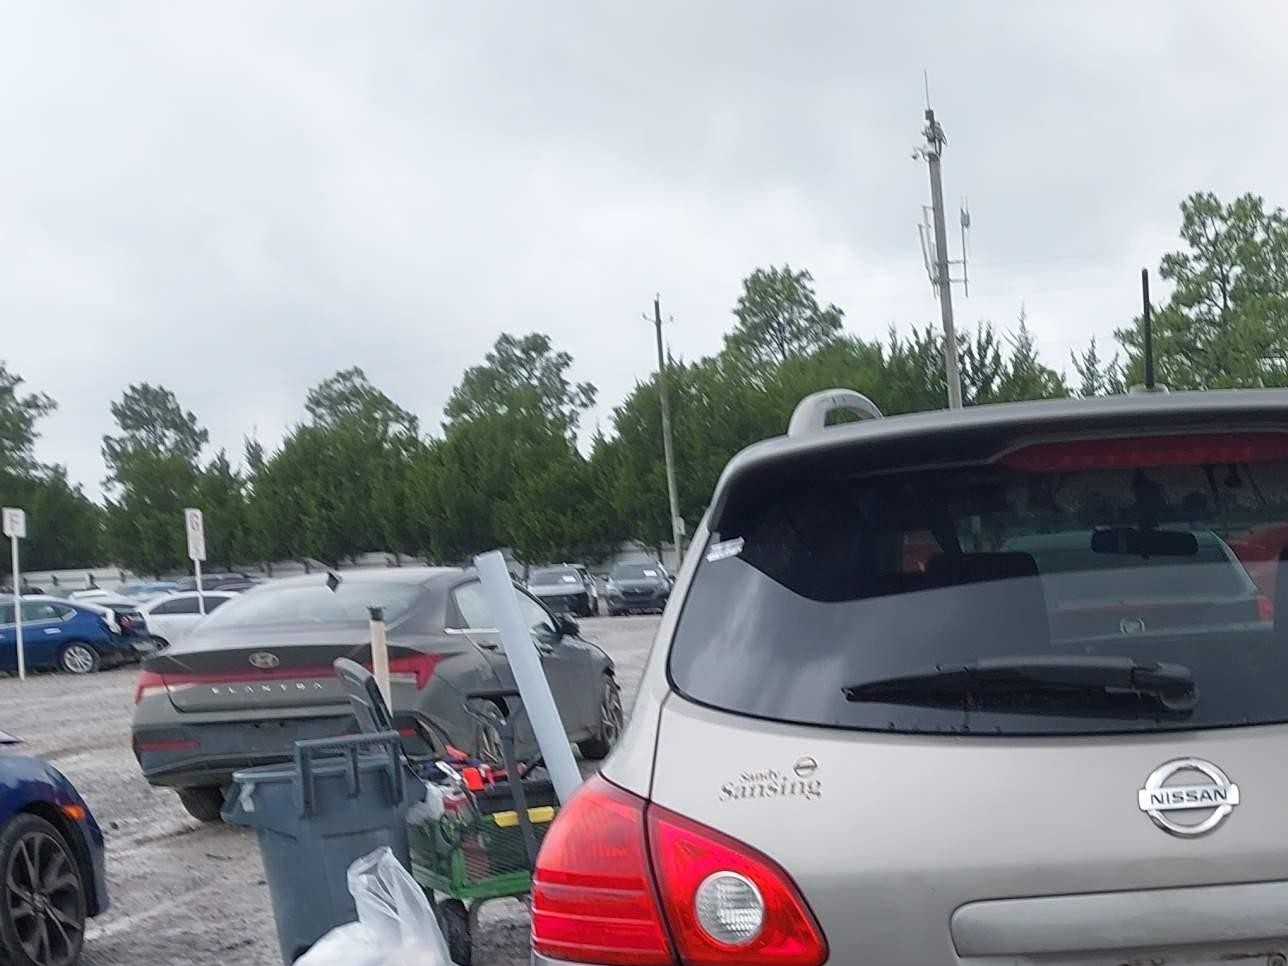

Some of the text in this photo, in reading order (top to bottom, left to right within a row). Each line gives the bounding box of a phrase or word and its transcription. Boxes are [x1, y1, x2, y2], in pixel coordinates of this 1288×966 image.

[210, 681, 322, 696] ELANTRA
[739, 768, 780, 786] Sandy
[719, 777, 821, 801] Sansing
[1150, 788, 1228, 805] NISSAN
